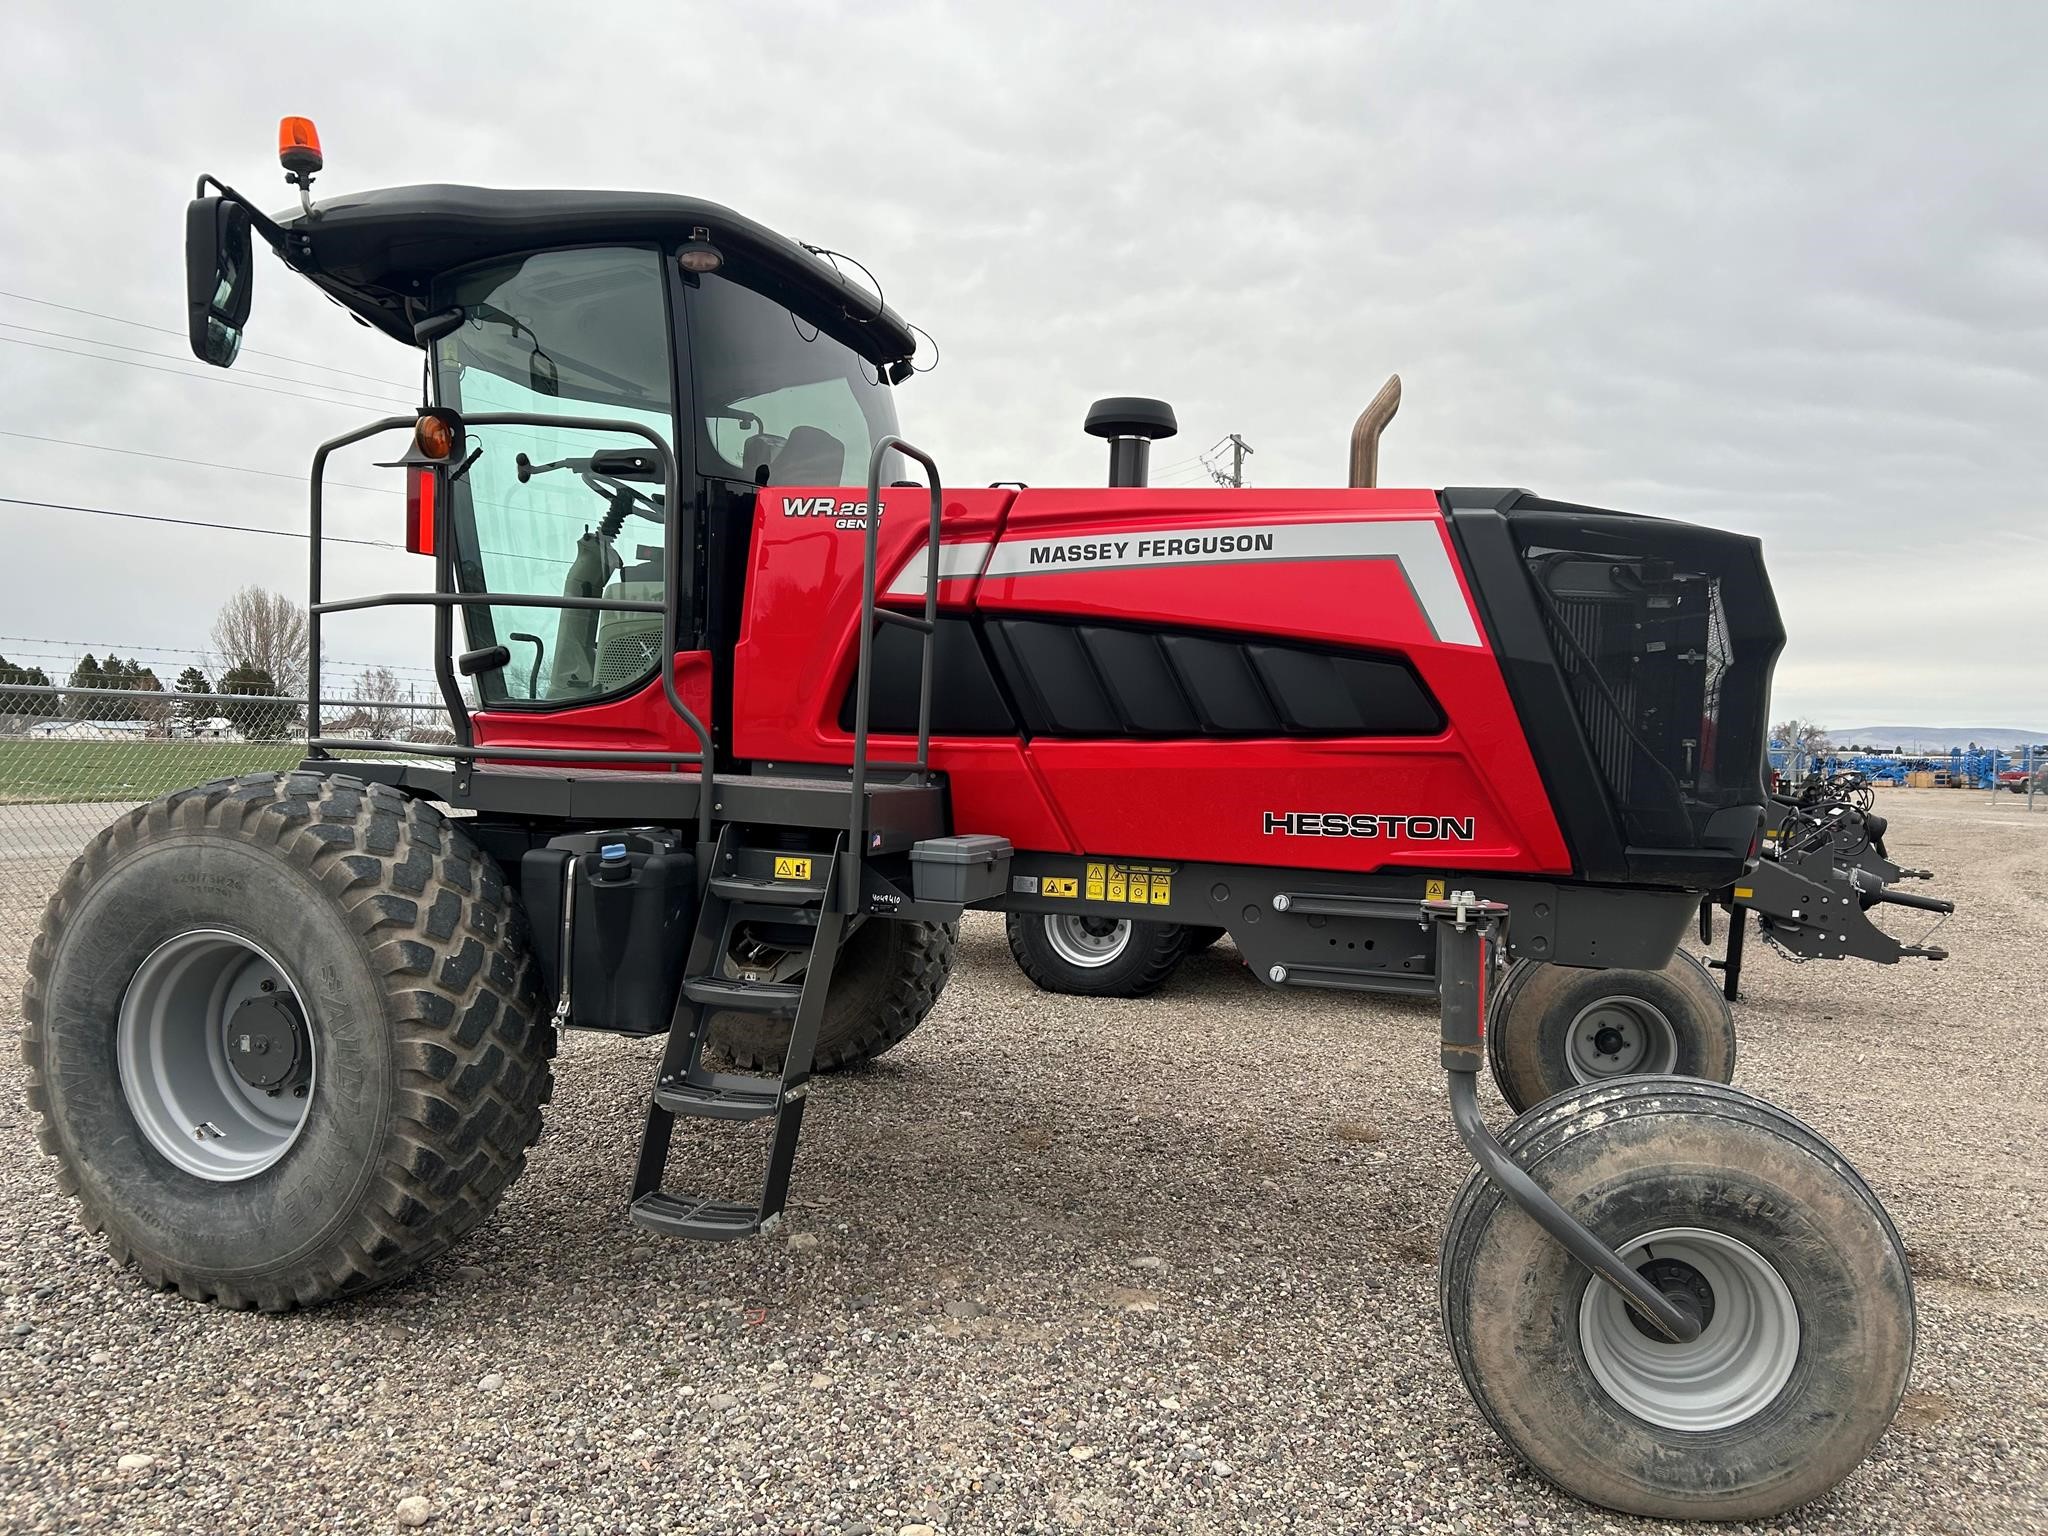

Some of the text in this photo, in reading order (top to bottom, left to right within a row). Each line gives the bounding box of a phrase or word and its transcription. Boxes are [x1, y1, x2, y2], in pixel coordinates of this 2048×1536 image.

[1029, 534, 1274, 564] MASSEY FERGUSON
[1263, 811, 1475, 841] HESSTON
